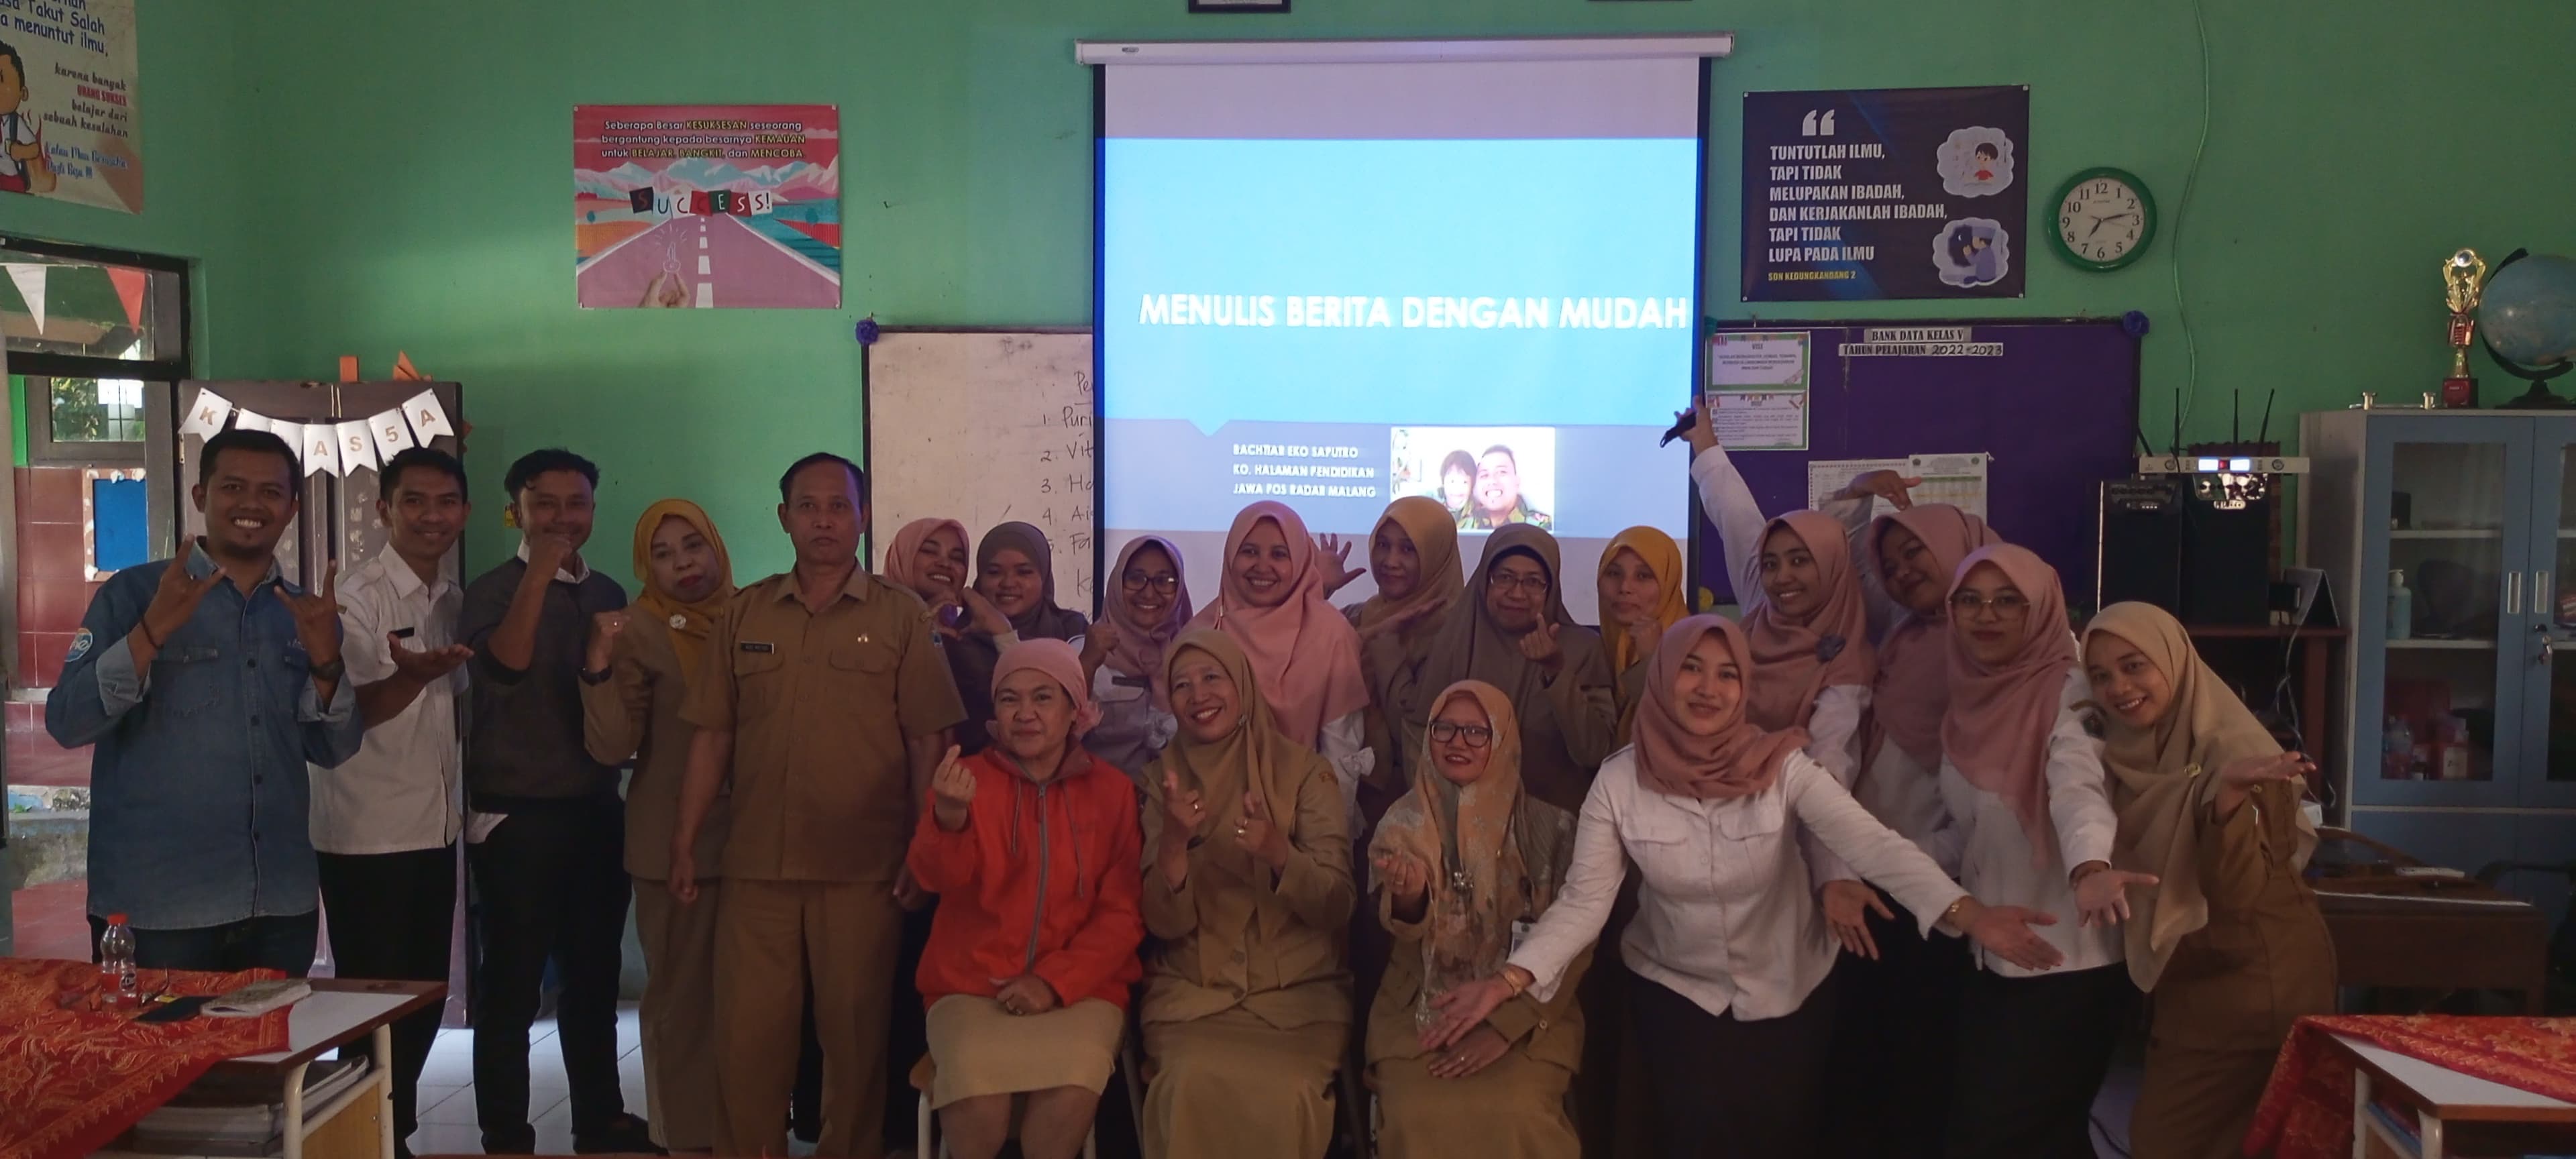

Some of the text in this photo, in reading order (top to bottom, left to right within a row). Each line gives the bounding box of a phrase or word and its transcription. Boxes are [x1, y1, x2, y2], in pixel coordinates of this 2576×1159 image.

[28, 0, 64, 23] Takut
[70, 12, 105, 35] Salah
[15, 17, 74, 45] menuntut
[80, 32, 108, 56] ilmu,
[54, 62, 125, 91] karena banyak
[72, 99, 127, 123] belajar dari
[43, 111, 128, 138] sebuah kesalahan
[605, 121, 802, 131] Seberapa Besar KESUKSESAN seseorang
[601, 135, 805, 145] bergantung kepada besarnya KEMAUAN
[601, 149, 629, 157] untuk
[729, 149, 748, 157] dan
[1770, 144, 1885, 160] TUNTUTLAH ILMU,
[1770, 164, 1842, 180] TAPI TIDAK
[1770, 184, 1904, 201] MELUPAKAN IBADAH,
[2080, 188, 2090, 200] 11
[2095, 182, 2108, 194] 12
[2116, 188, 2121, 199] 1
[637, 192, 771, 215] SUCCESS!
[2068, 201, 2081, 213] 10
[2127, 199, 2135, 209] 2
[1769, 203, 1947, 222] DAN KERJAKANLAH IBADAH,
[2062, 217, 2070, 228] 9
[2132, 215, 2140, 226] 3
[1769, 226, 1841, 242] TAPI TIDAK
[2067, 231, 2075, 242] 8
[2127, 229, 2133, 240] 4
[2082, 243, 2088, 254] 7
[2097, 247, 2105, 258] 6
[2115, 241, 2123, 253] 5
[1768, 245, 1875, 262] LUPA PADA ILMU
[1851, 271, 1856, 279] 2
[1138, 293, 1688, 330] MENULIS BERITA DENGAN MUDAH
[1872, 329, 1964, 341] BANK DATA KELAS V
[1844, 345, 1872, 355] TAHUN
[1875, 344, 1926, 356] PELAJARAN
[199, 405, 363, 456] KAS
[1233, 443, 1358, 458] BACHTIAR EKO SAPUTRO
[1233, 463, 1375, 478] KO. HALAMAN PENDIDIKAN
[1233, 483, 1376, 498] JAWA POS RADAR MALANG
